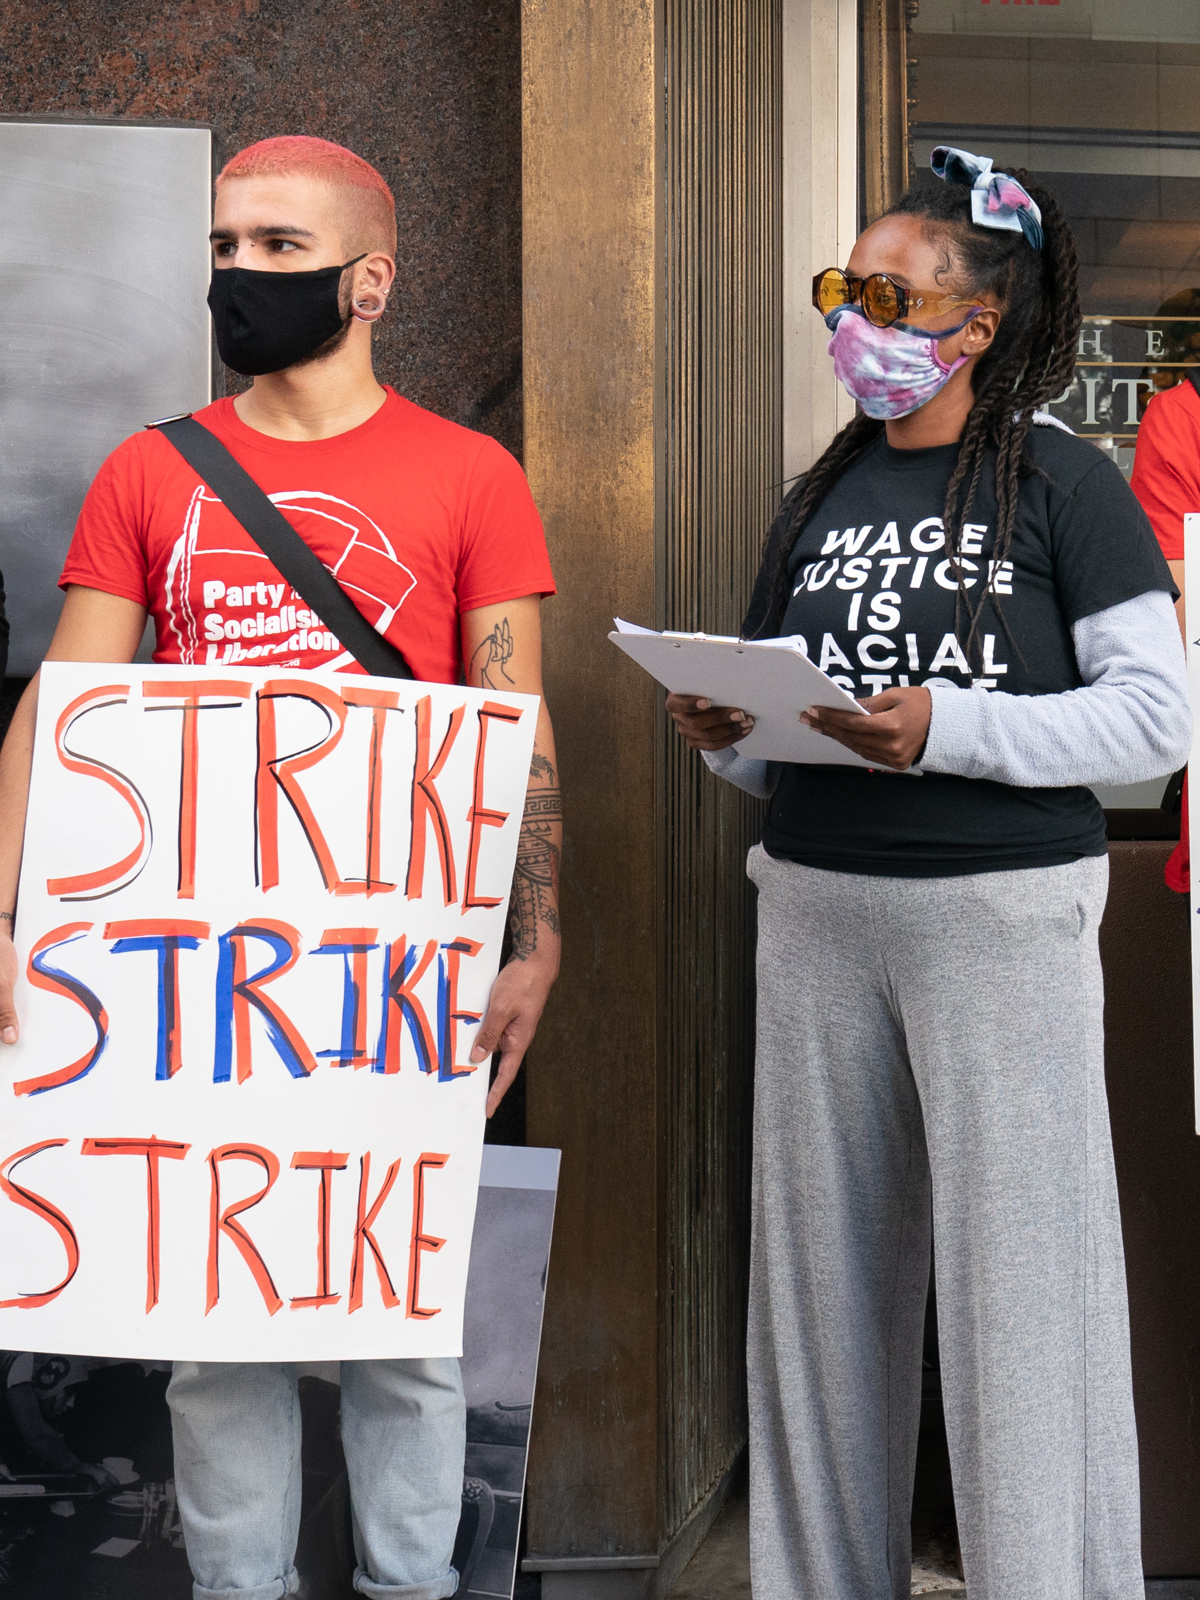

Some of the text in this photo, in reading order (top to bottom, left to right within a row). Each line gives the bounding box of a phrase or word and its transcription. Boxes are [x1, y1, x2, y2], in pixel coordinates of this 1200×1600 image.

[820, 517, 988, 556] WAGE
[203, 580, 286, 609] Party
[793, 556, 1014, 597] JUSTICE
[847, 591, 902, 632] IS
[205, 629, 340, 666] Liberation
[46, 679, 525, 915] STRIKE
[13, 917, 485, 1097] STRIKE
[0, 1134, 451, 1321] STRIKE
